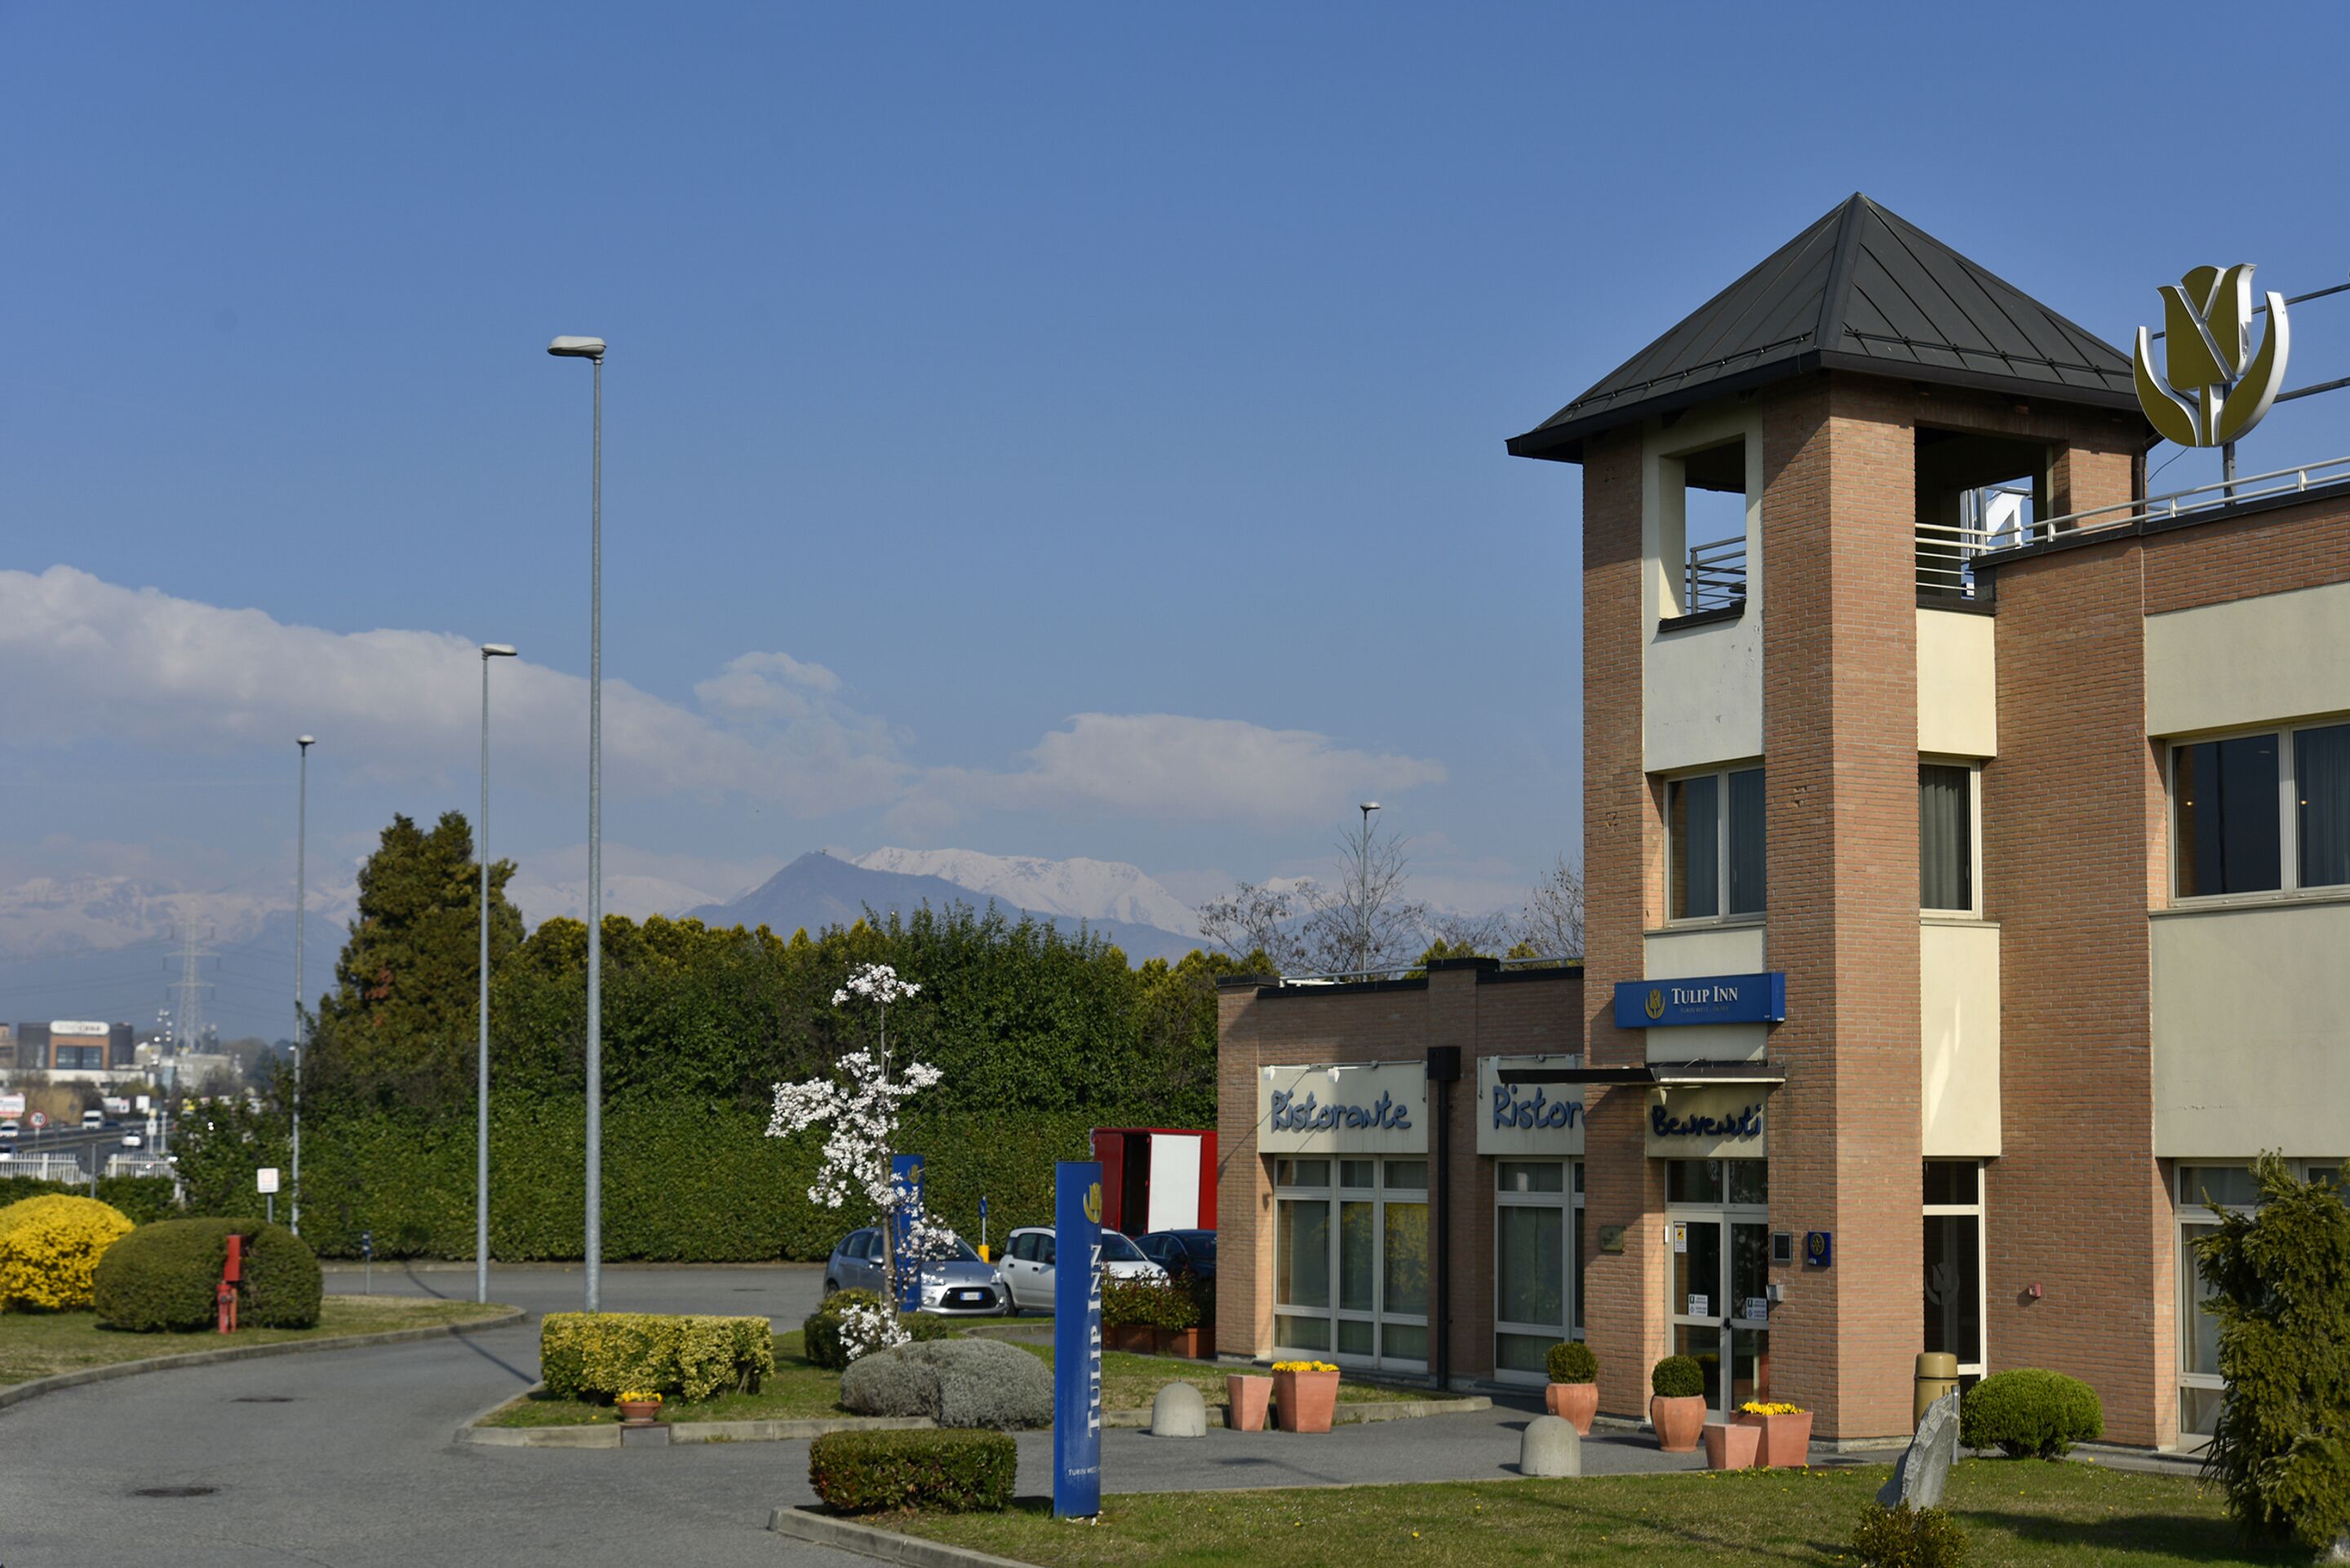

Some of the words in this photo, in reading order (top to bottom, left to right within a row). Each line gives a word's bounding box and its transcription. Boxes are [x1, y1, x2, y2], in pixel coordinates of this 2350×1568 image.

[1671, 988, 1709, 1004] TULIP
[1713, 986, 1738, 1003] INN
[1270, 1089, 1412, 1131] Ristorante
[1493, 1084, 1585, 1130] Ristor
[1652, 1104, 1762, 1136] Benvenuti
[1088, 1244, 1102, 1313] INN
[1088, 1325, 1102, 1438] TULIP
